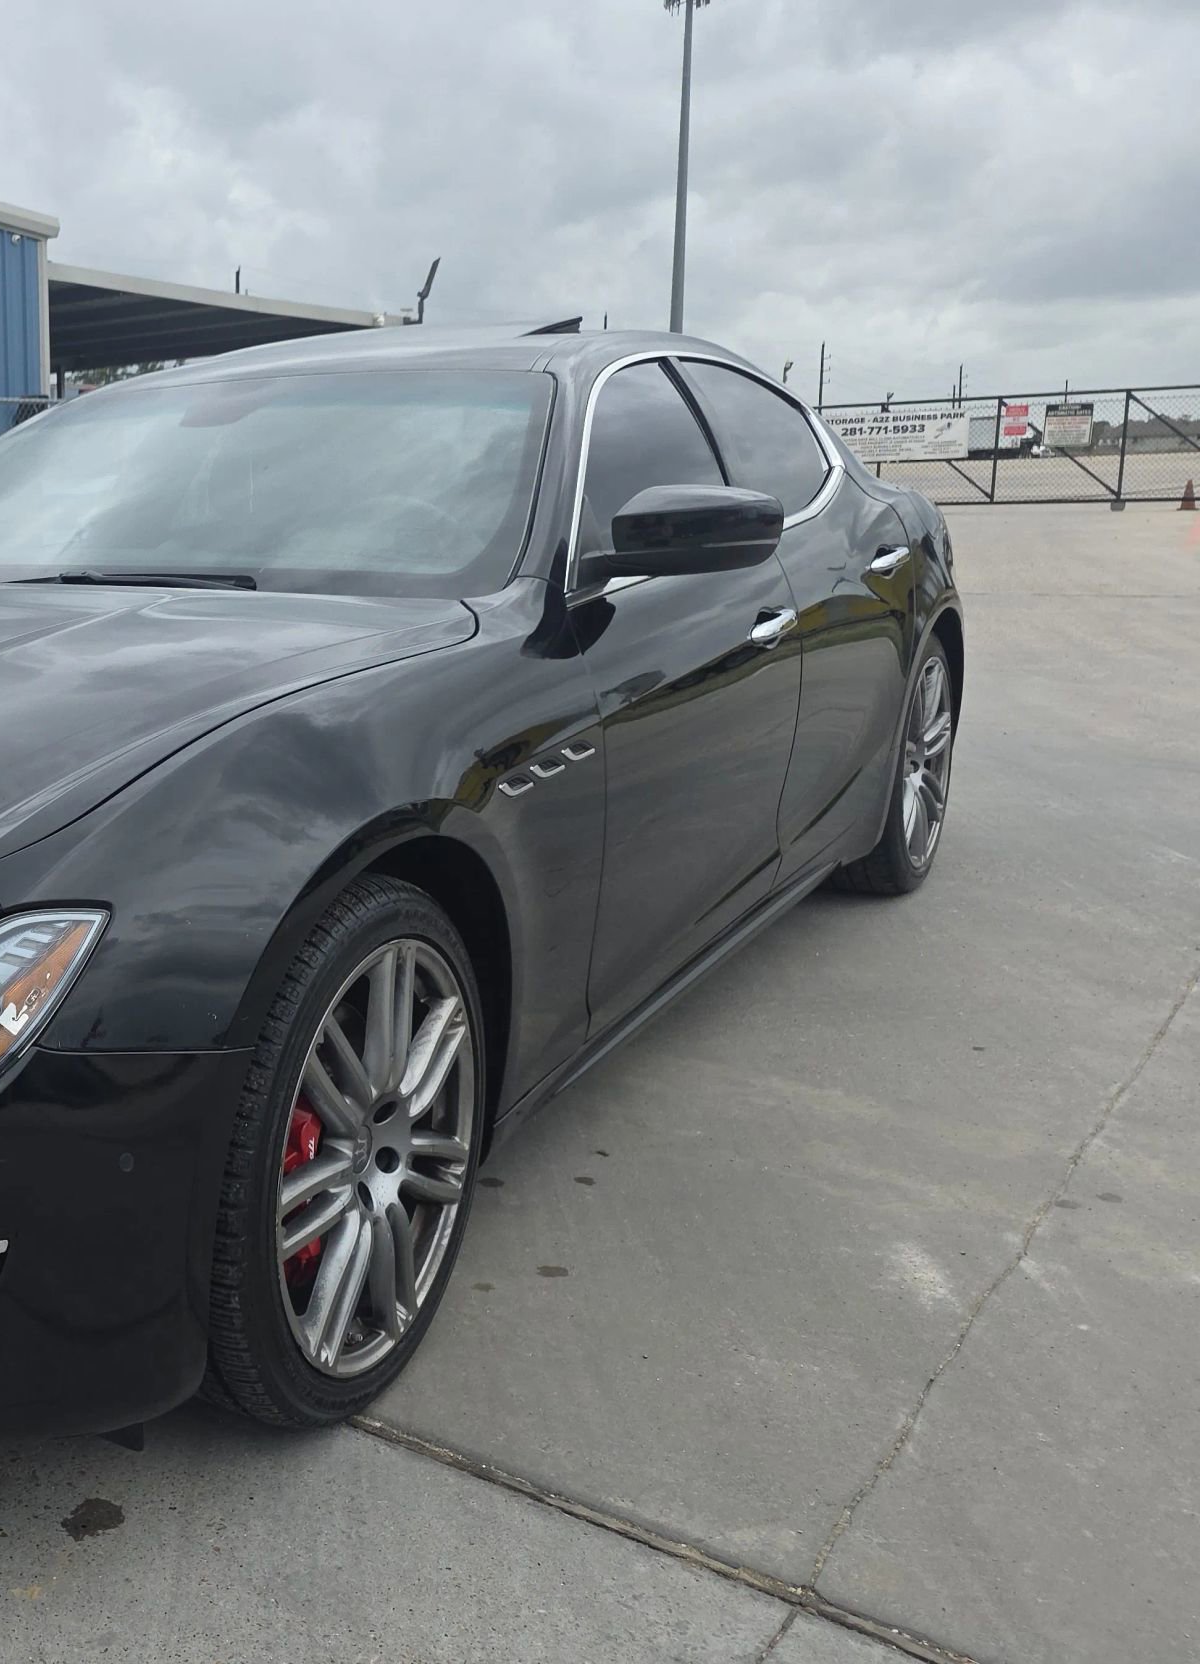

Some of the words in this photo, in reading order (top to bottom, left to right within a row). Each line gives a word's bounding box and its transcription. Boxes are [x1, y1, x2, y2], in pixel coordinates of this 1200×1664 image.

[892, 413, 938, 423] BUSINESS
[940, 411, 966, 420] PARK
[841, 423, 926, 437] 281-771-5933
